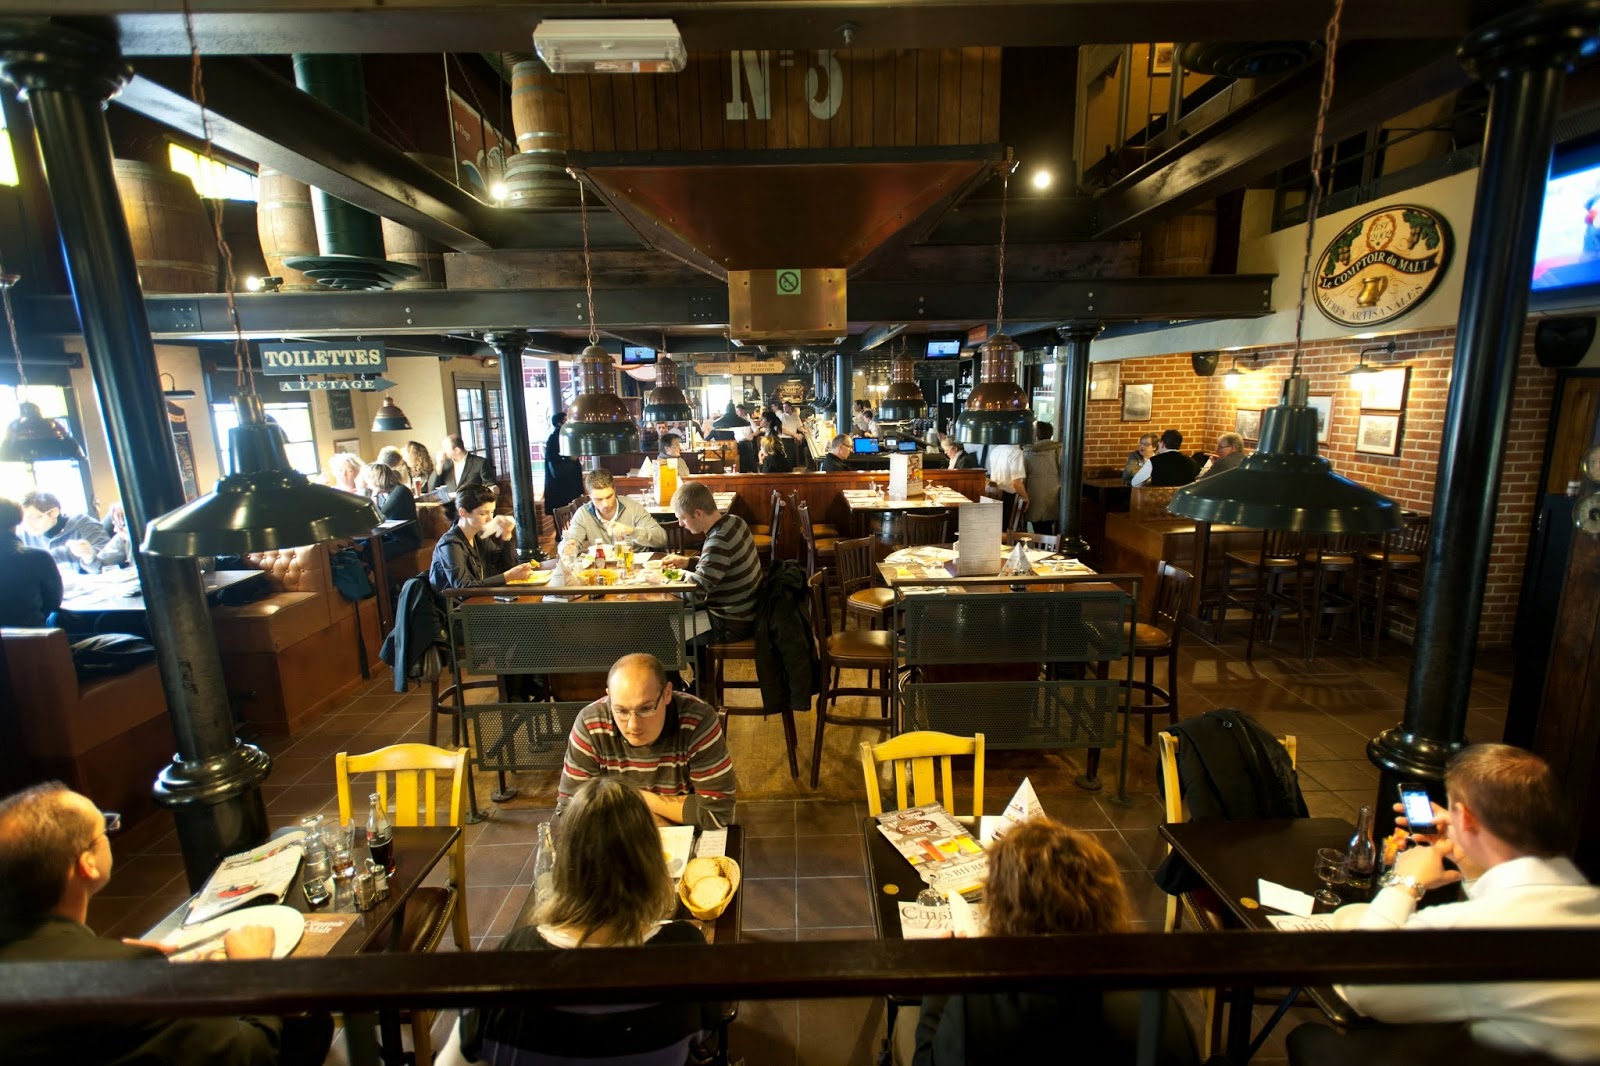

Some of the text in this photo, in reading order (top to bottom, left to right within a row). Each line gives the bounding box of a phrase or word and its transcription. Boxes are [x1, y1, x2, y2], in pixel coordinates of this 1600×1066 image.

[1322, 251, 1430, 289] Le COMPTOIR du MALT
[1349, 283, 1423, 321] ARTISANALES
[264, 349, 382, 367] TOILETTES
[300, 380, 375, 389] L'ETAGE
[901, 906, 978, 920] Cuisie
